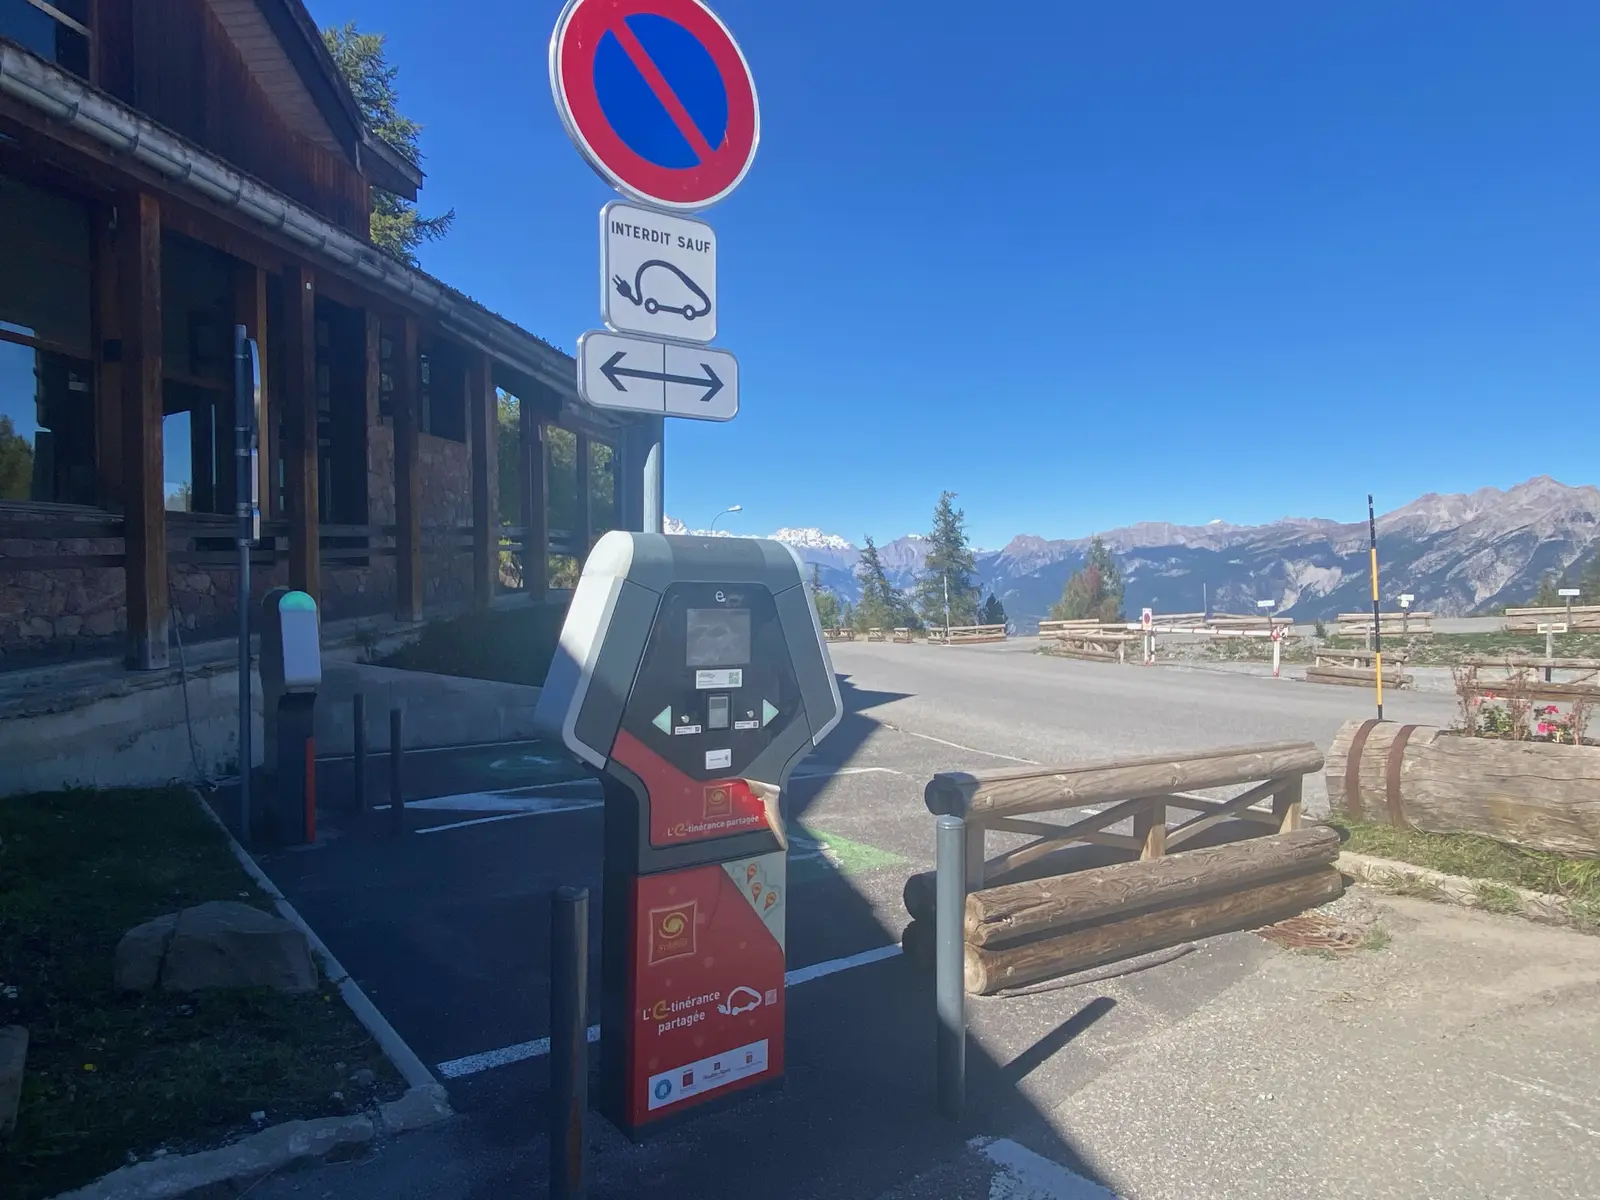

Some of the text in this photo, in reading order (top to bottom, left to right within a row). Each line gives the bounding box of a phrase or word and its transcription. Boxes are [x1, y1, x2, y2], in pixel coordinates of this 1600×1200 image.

[611, 221, 711, 253] INTERDIT SAUF
[726, 812, 760, 828] partagée
[658, 1009, 706, 1036] partagée
